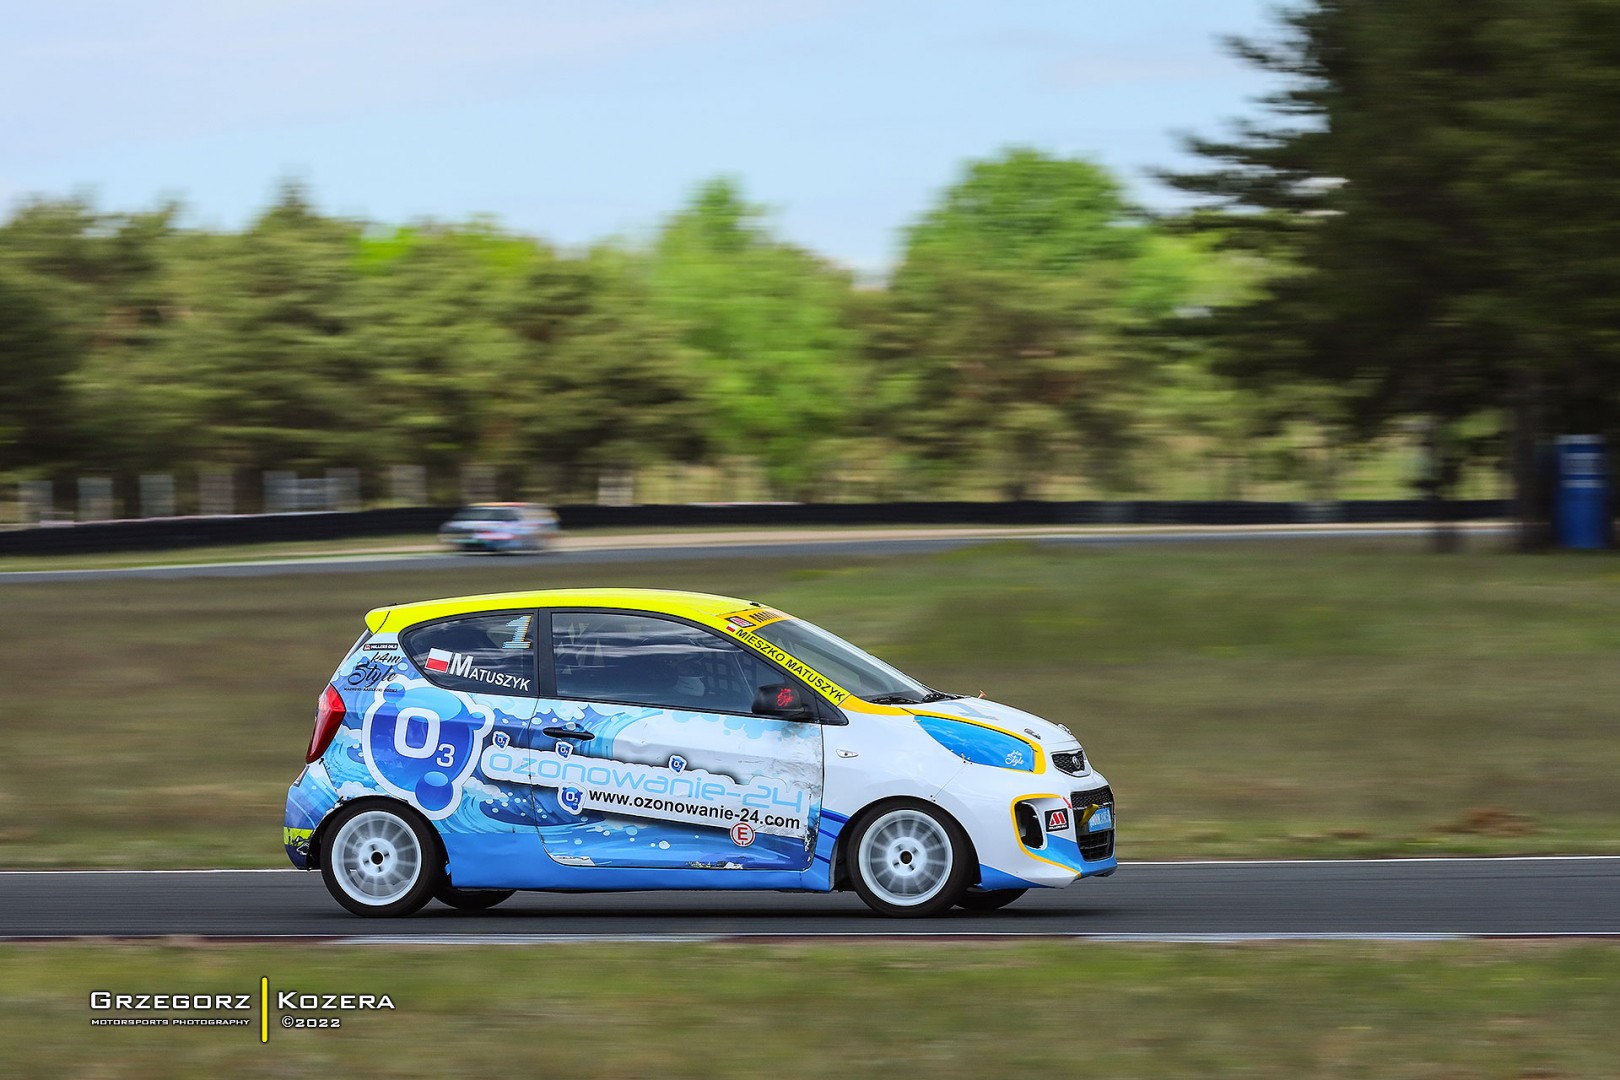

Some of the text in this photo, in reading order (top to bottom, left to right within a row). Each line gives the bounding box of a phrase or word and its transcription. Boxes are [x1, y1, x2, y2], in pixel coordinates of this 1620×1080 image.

[502, 615, 532, 649] 1
[347, 660, 398, 689] Style
[735, 628, 785, 662] MIESZKO
[785, 659, 846, 701] MATUSZYK
[489, 753, 803, 813] ozonowanie-24
[589, 790, 800, 830] www.ozonowanie-24.com
[737, 826, 749, 841] E
